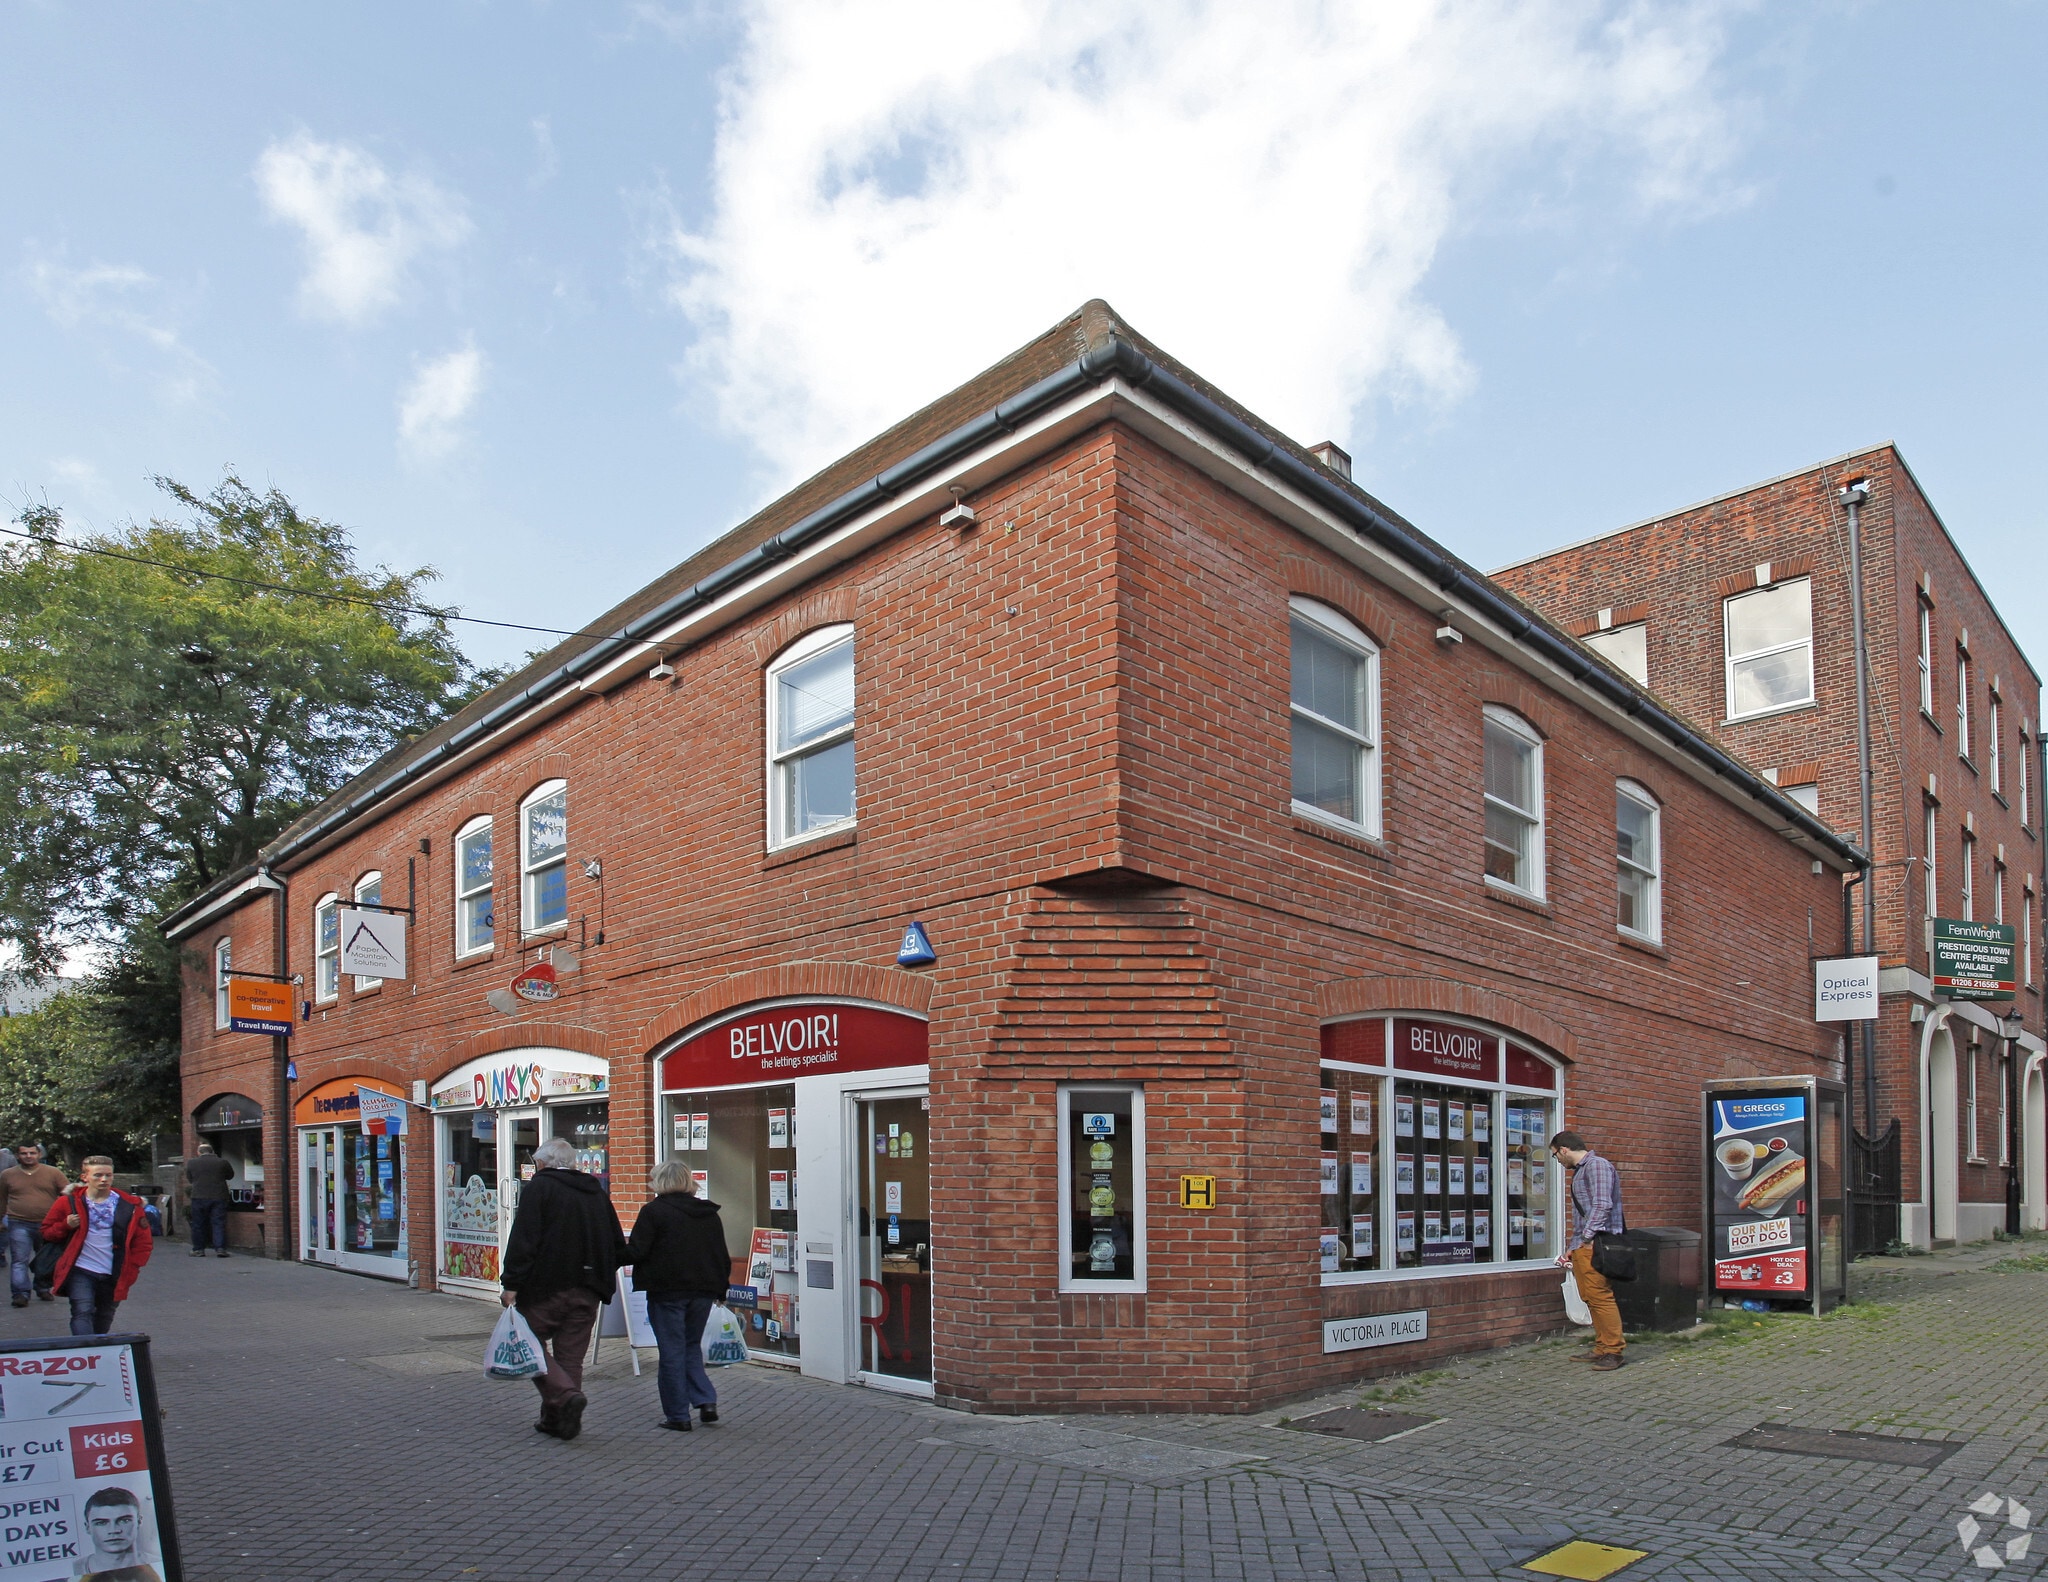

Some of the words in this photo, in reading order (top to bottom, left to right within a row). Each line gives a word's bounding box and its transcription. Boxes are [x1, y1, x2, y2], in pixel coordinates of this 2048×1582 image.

[1948, 924, 2001, 940] FennWright
[356, 945, 379, 953] Paper
[901, 948, 919, 956] Chubb
[1938, 942, 1988, 953] PRESTIGIOUS
[1989, 946, 2011, 956] TOWN
[351, 952, 388, 960] Mountain
[1940, 952, 1971, 960] CENTRE
[1972, 954, 2008, 964] PREMISES
[354, 959, 387, 968] Solutions
[1955, 962, 1995, 972] AVAILABLE
[1823, 977, 1868, 989] Optical
[1951, 978, 1972, 986] 01206
[254, 988, 268, 996] The
[1821, 990, 1872, 1002] Express
[236, 995, 286, 1004] co-operative
[252, 1004, 272, 1012] travel
[237, 1021, 260, 1029] Travel
[262, 1023, 287, 1033] Money
[730, 1014, 838, 1059] BELVOIR!
[1411, 1026, 1482, 1060] BELVOIR!
[761, 1058, 773, 1069] the
[774, 1054, 801, 1068] lettings
[802, 1051, 838, 1065] specialist
[1434, 1056, 1442, 1064] the
[1443, 1057, 1460, 1069] lettings
[1460, 1061, 1481, 1071] specialist
[474, 1062, 542, 1107] DINKY'S
[454, 1090, 471, 1098] TREATS
[1743, 1104, 1785, 1112] GREGGS
[1732, 1225, 1756, 1236] OUR
[1760, 1220, 1786, 1232] NEW
[1732, 1235, 1755, 1246] HOT
[1760, 1230, 1788, 1242] DOG
[1775, 1271, 1794, 1284] £3
[1332, 1324, 1384, 1343] VICTORIA
[1391, 1319, 1420, 1336] PLACE
[24, 1439, 64, 1455] Cut
[84, 1432, 134, 1449] Kids
[95, 1452, 128, 1471] £6
[2, 1464, 36, 1483] £7
[6, 1520, 68, 1542] DAYS
[8, 1543, 78, 1565] WEEK
